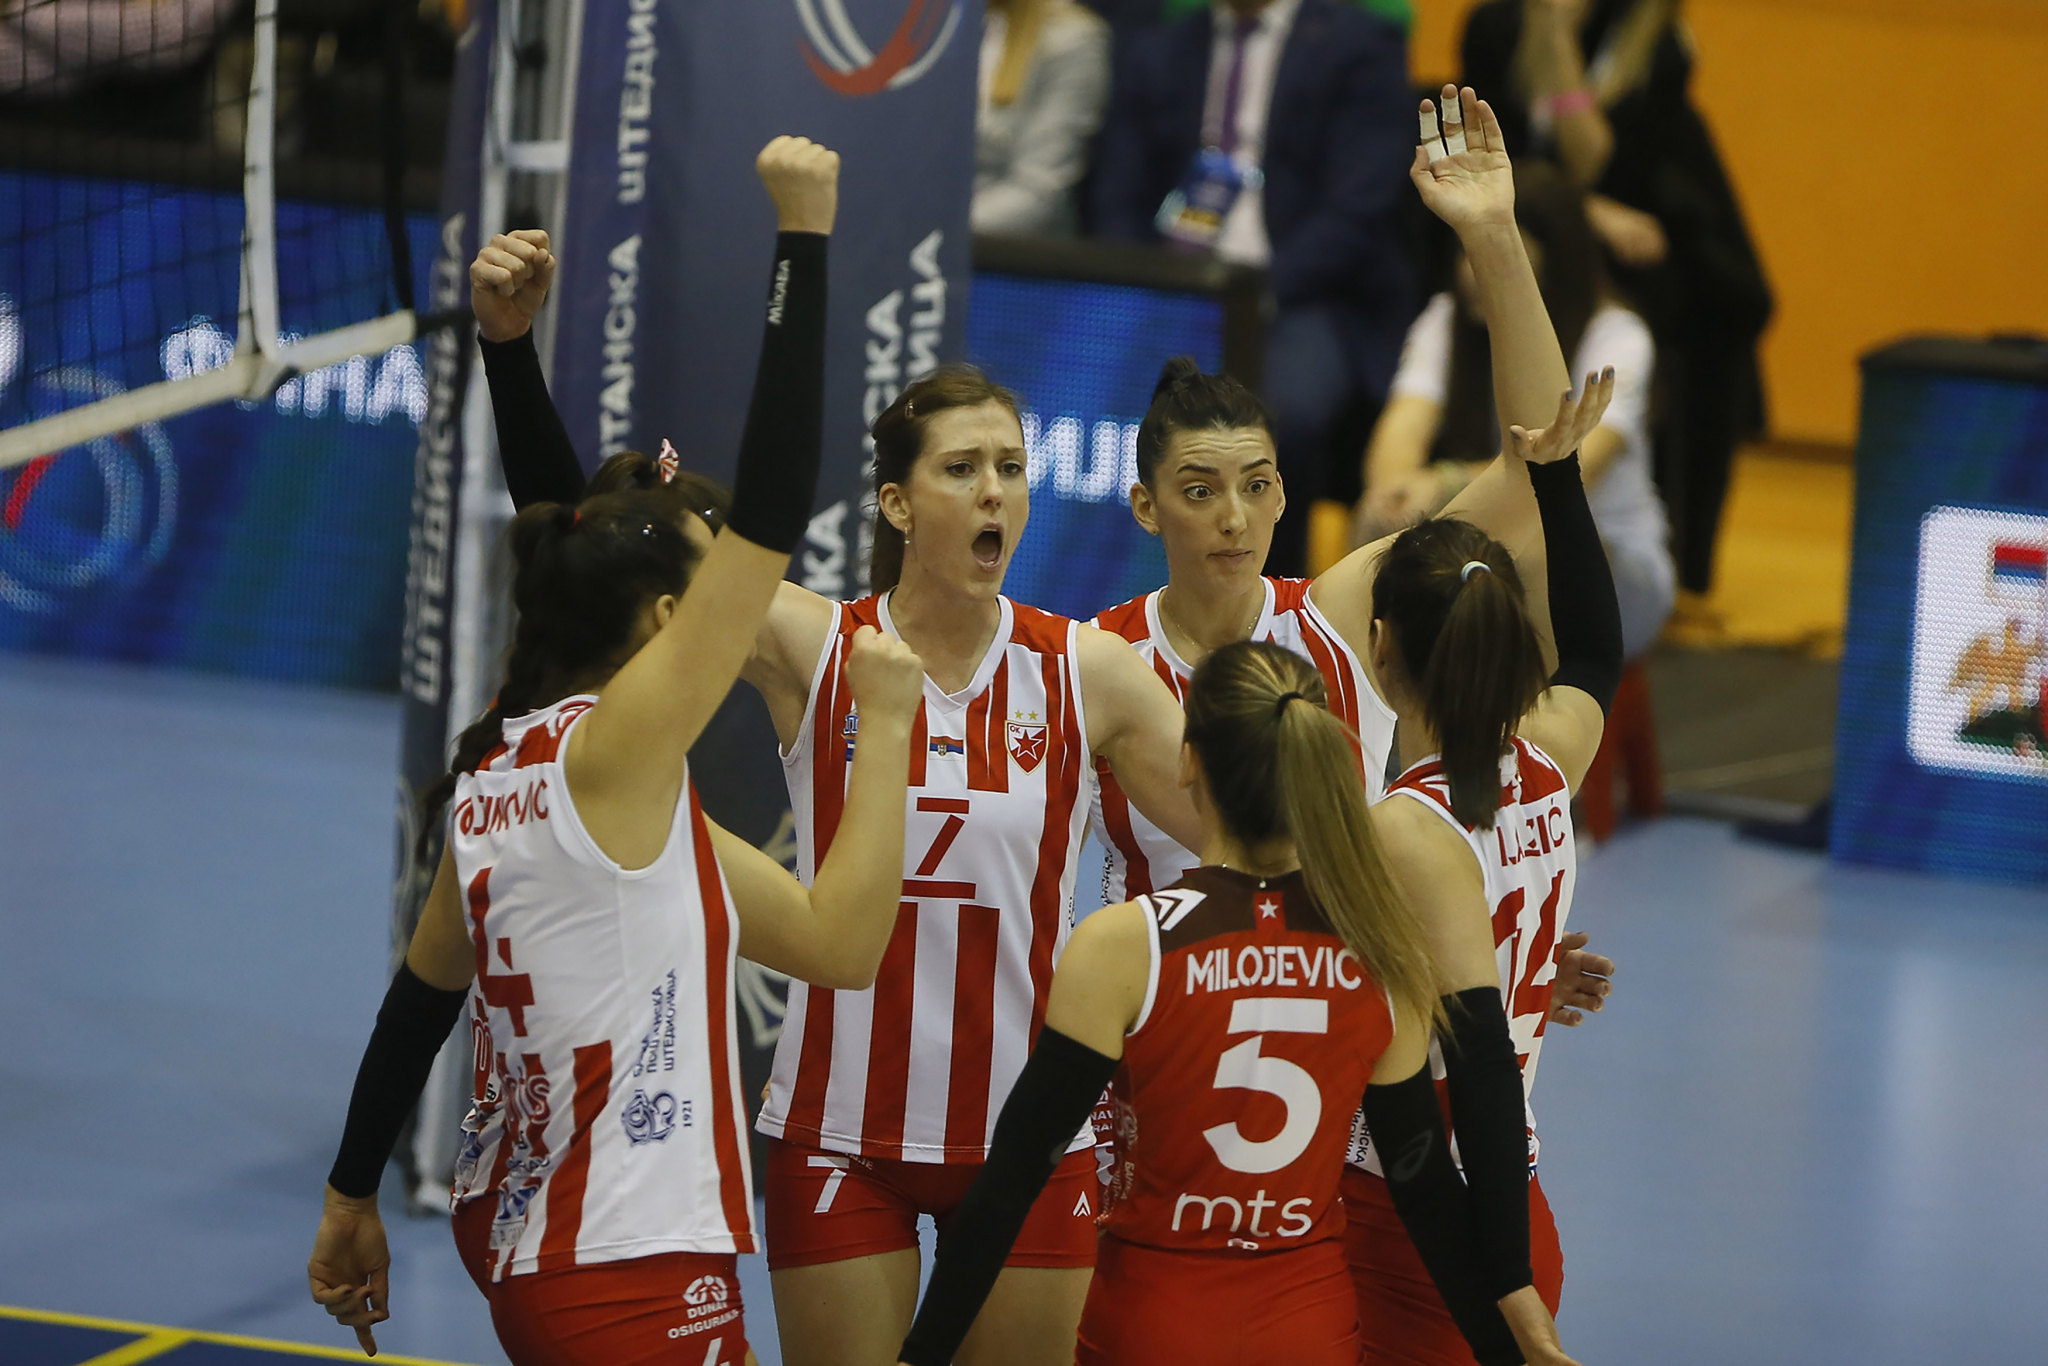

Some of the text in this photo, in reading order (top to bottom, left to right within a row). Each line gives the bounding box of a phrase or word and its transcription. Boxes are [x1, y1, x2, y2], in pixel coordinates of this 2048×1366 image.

[915, 797, 969, 876] 7
[682, 1100, 692, 1128] 1921
[1202, 997, 1329, 1174] 5
[807, 1155, 849, 1214] 7
[1171, 1189, 1313, 1238] mts
